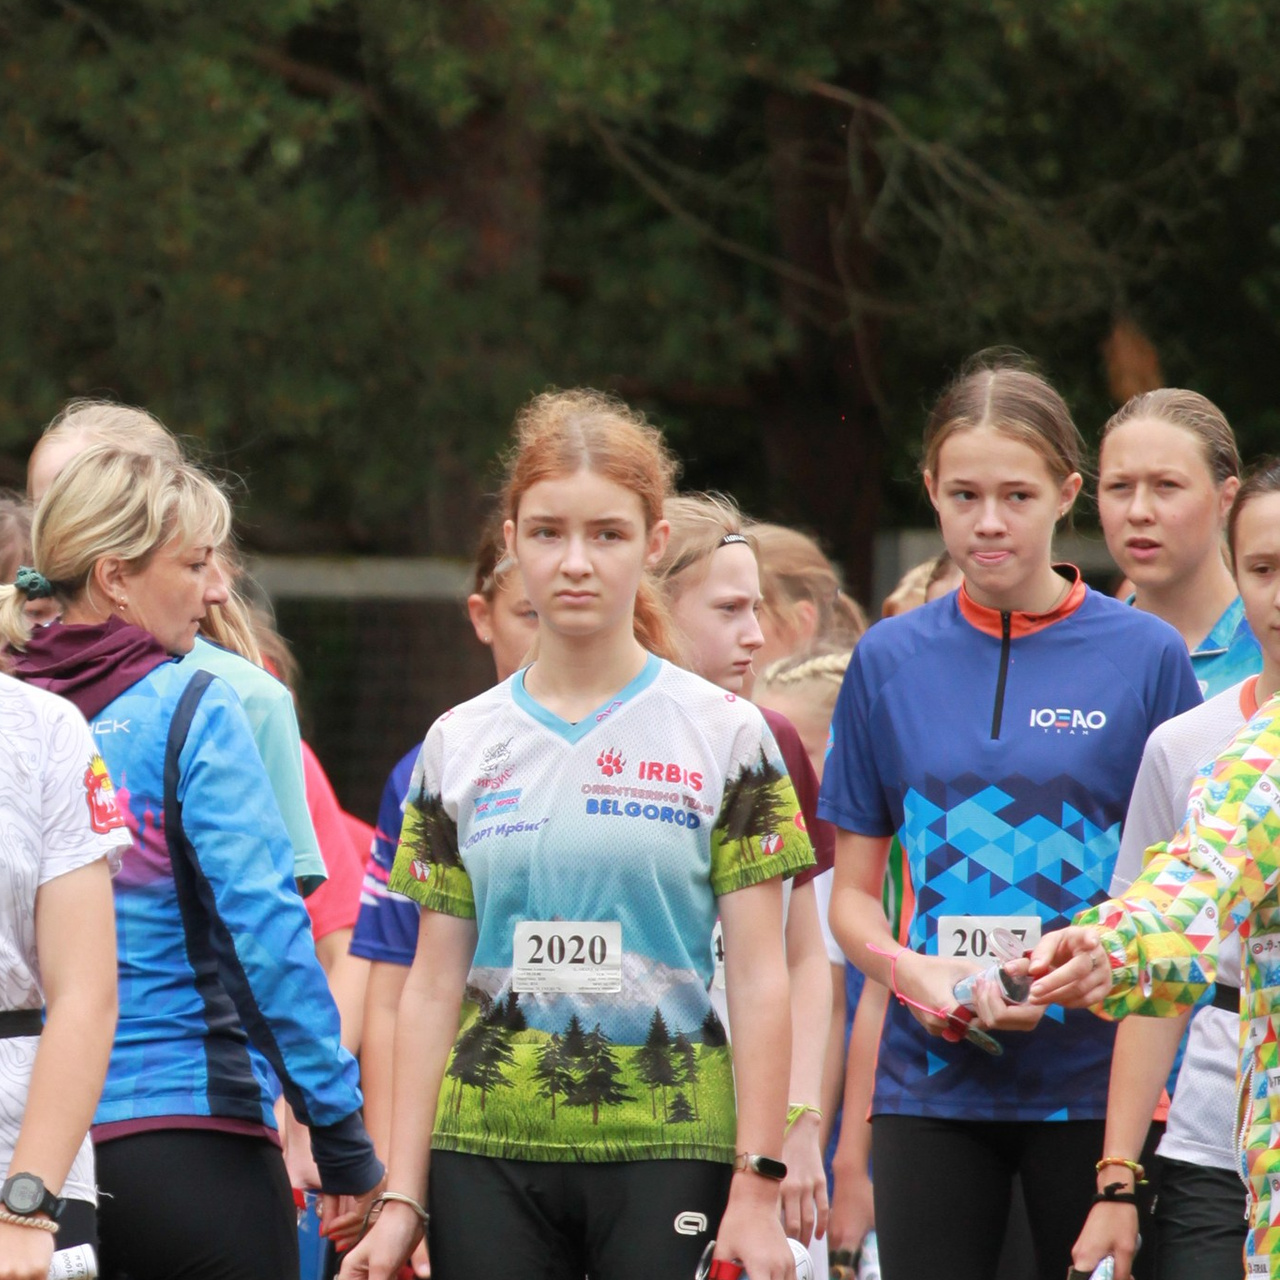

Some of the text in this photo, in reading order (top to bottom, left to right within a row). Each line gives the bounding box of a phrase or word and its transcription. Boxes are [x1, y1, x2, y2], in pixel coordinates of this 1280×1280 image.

[1043, 728, 1089, 736] TEAM
[638, 760, 703, 792] IRBIS
[586, 798, 700, 830] BELGOROD
[527, 934, 607, 965] 2020
